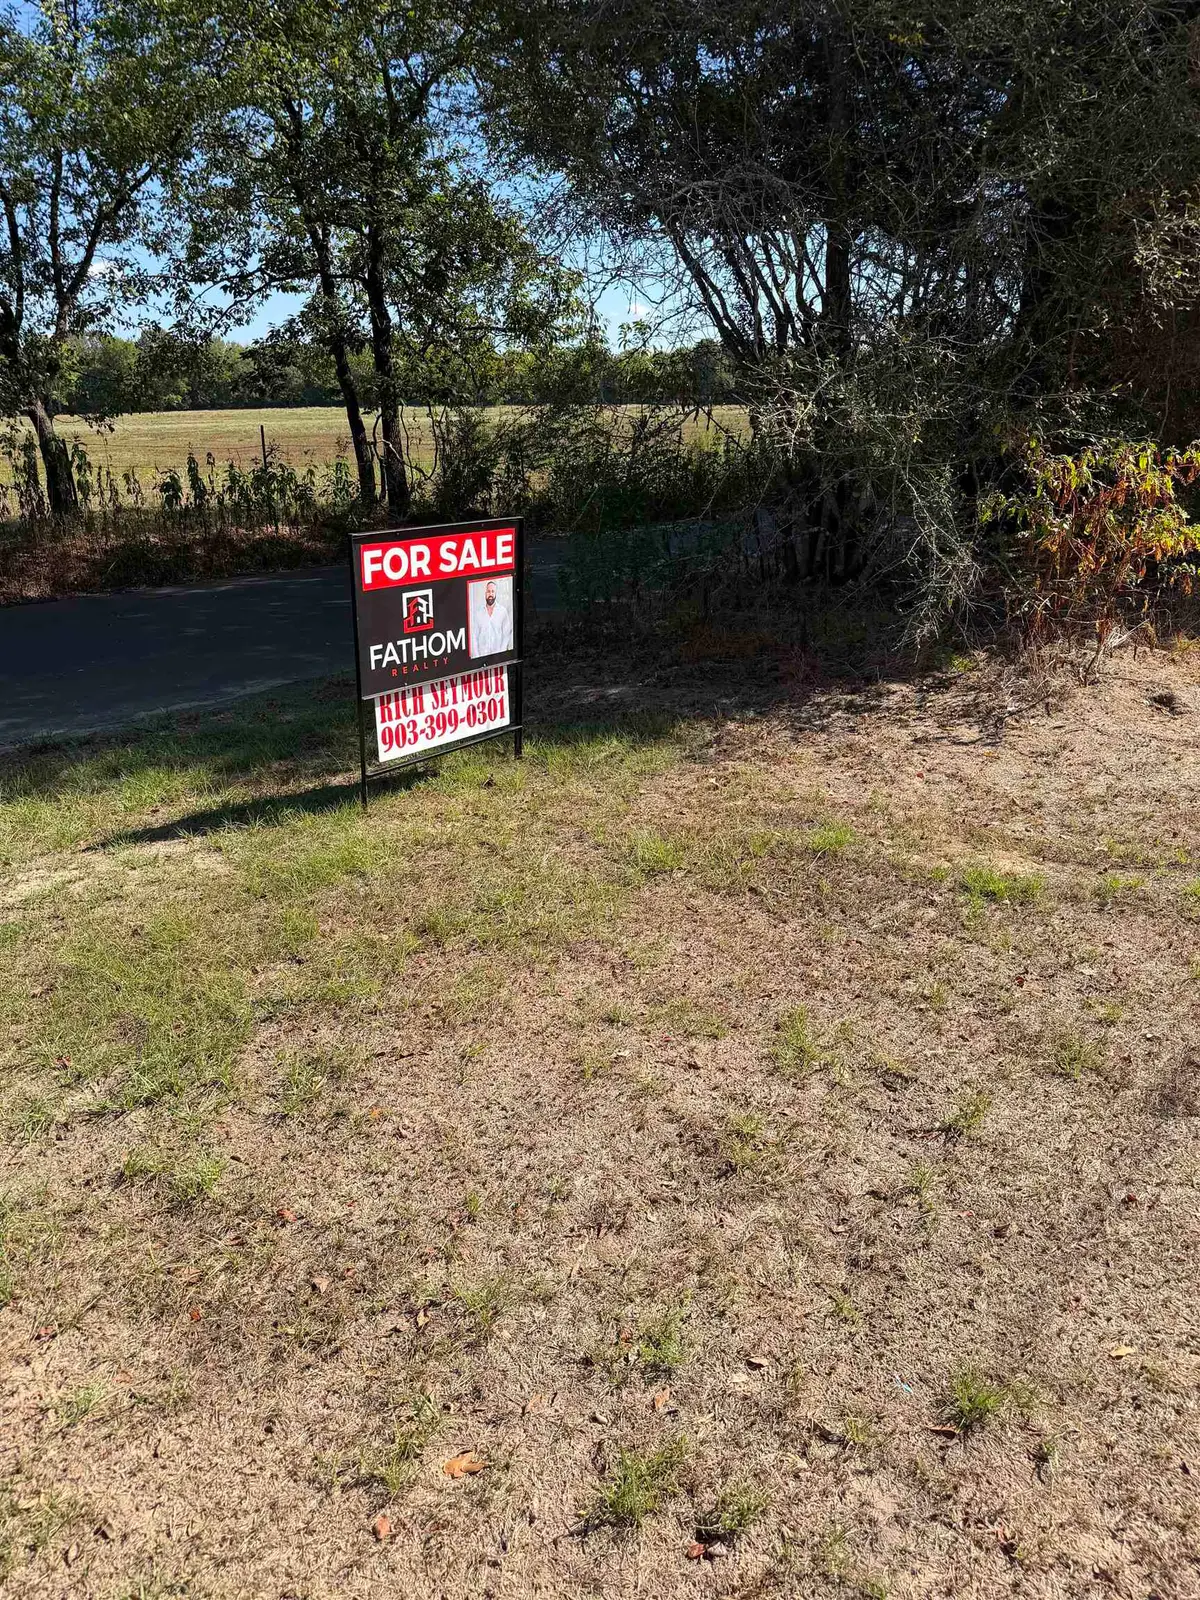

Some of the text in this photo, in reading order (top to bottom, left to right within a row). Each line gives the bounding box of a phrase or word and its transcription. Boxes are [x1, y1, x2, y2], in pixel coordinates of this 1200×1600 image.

[363, 534, 513, 584] FOR SALE
[369, 628, 466, 671] FATHOM
[391, 657, 449, 677] REALTY
[379, 666, 505, 724] RICH SEYMOUR
[381, 696, 506, 753] 903-399-0301
